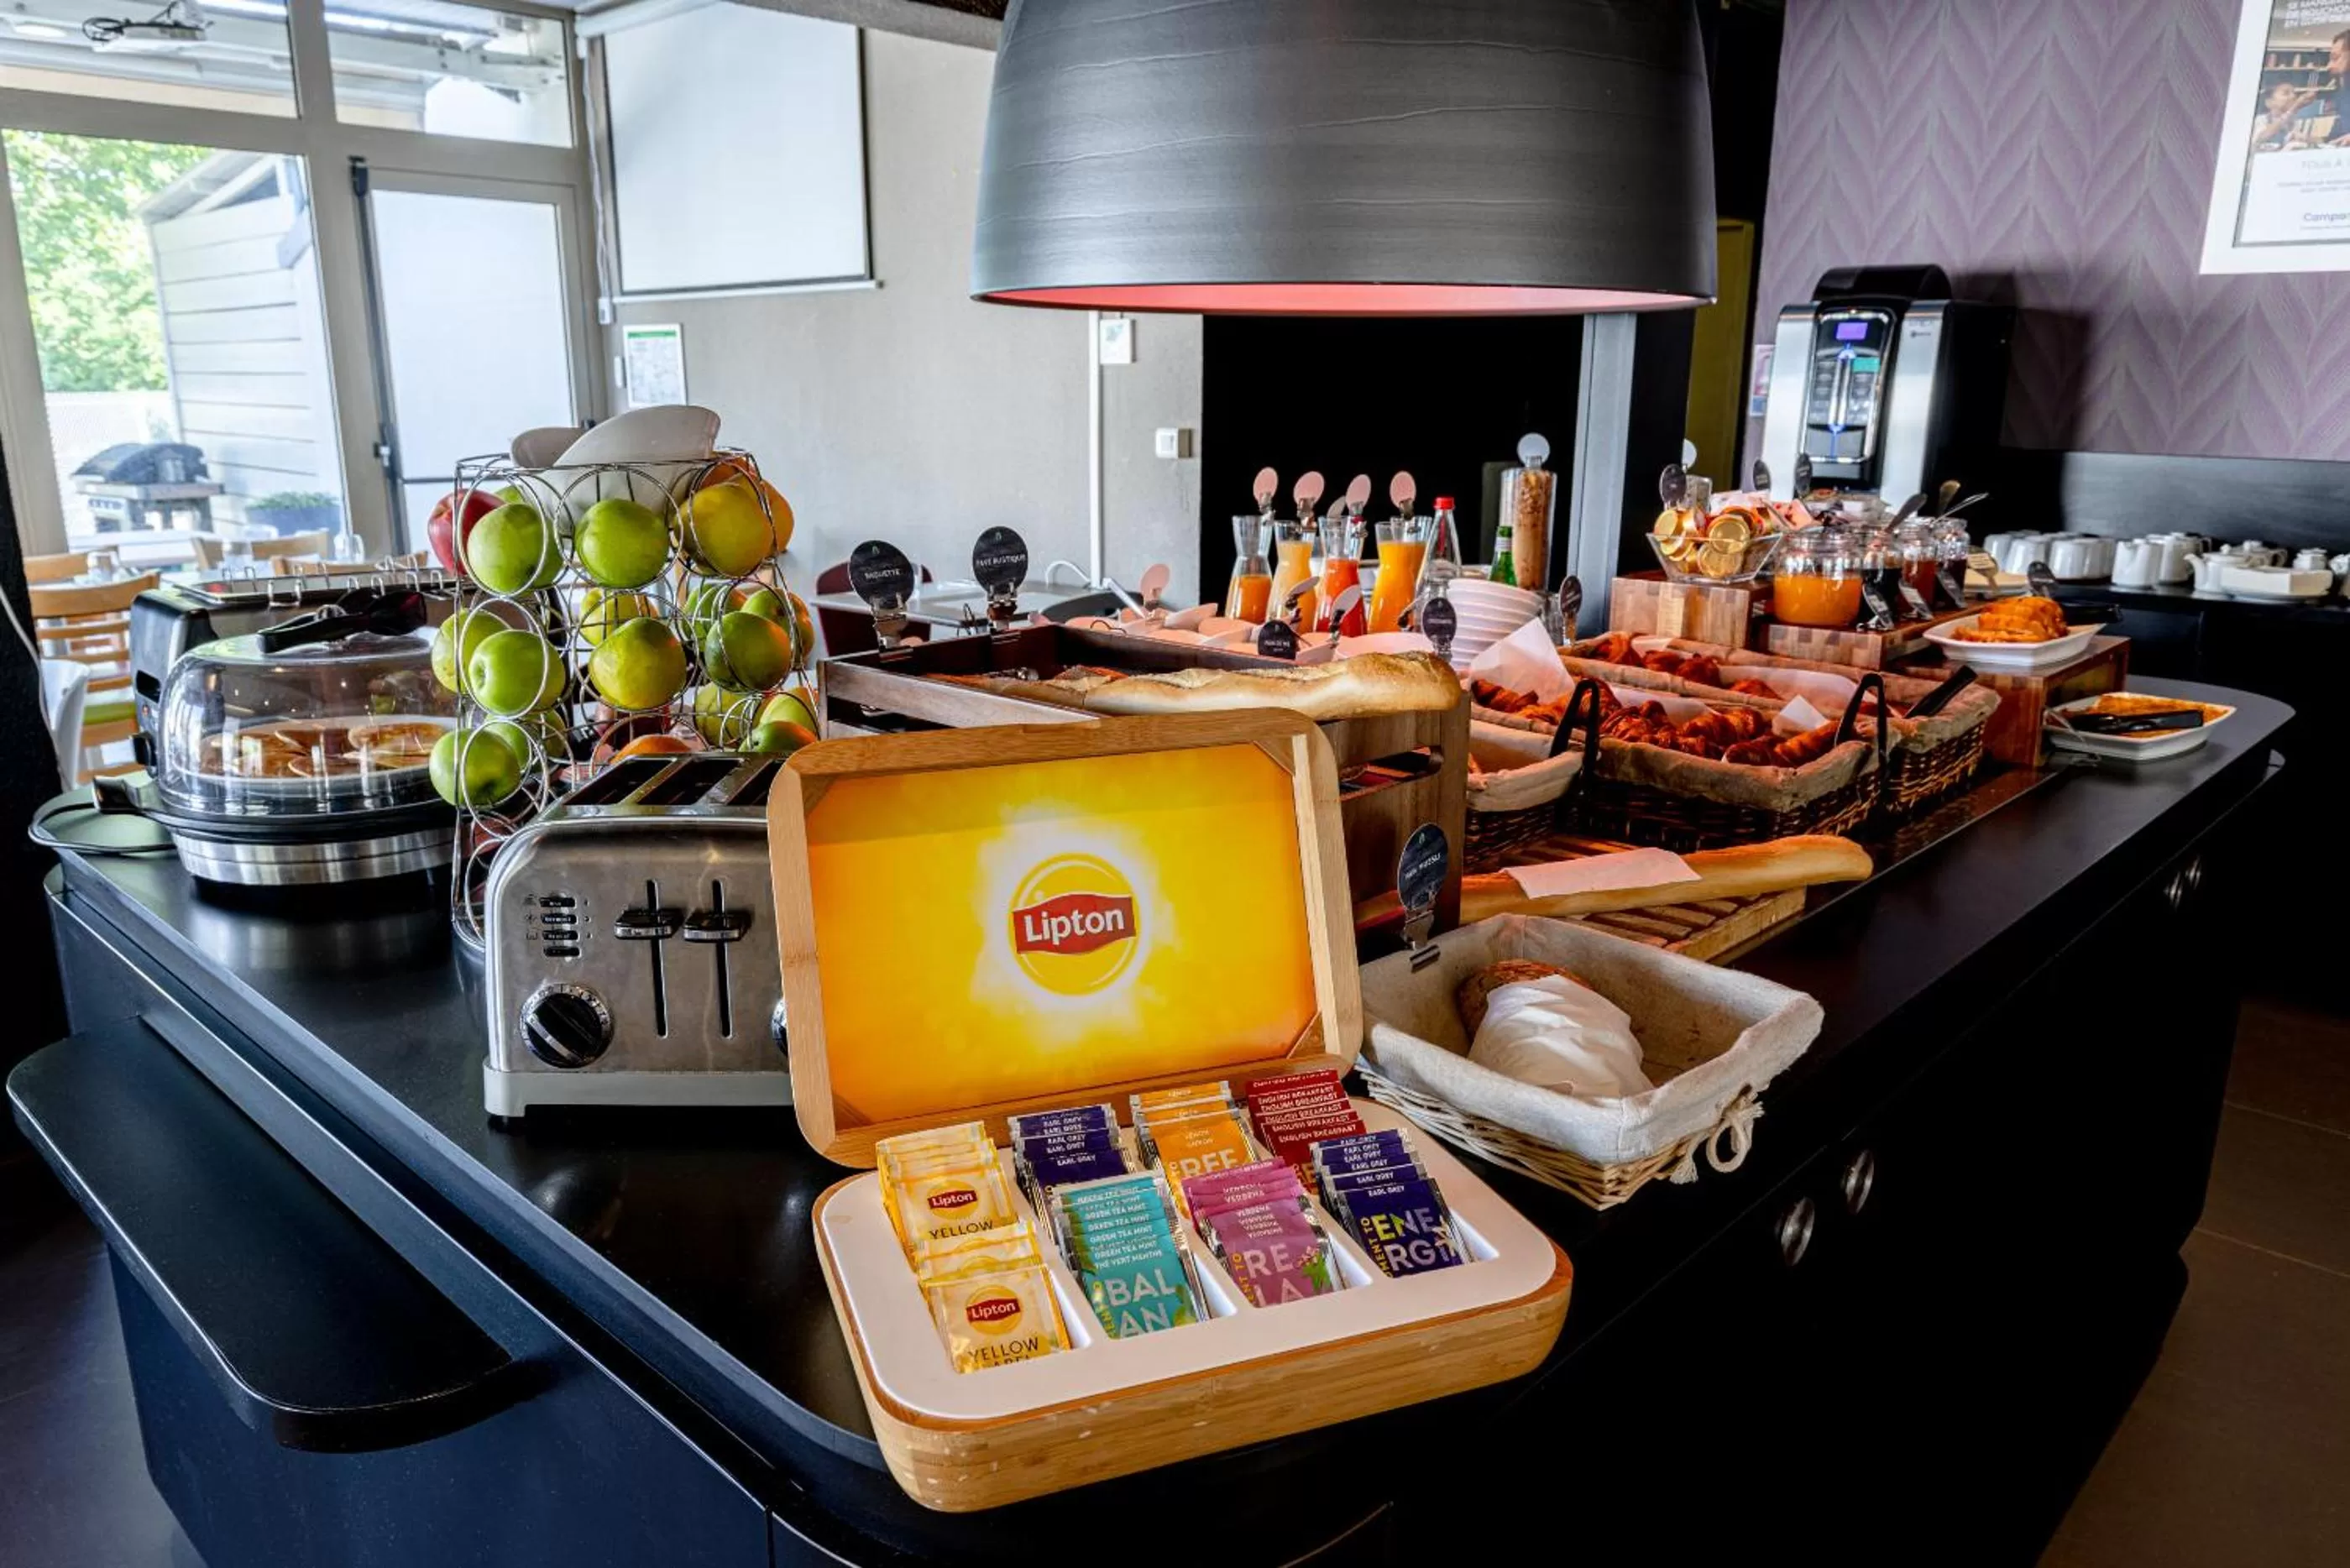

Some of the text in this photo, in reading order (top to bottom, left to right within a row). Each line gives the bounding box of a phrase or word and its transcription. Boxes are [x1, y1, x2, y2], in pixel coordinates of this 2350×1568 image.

[1023, 908, 1125, 946] Lipton
[932, 1190, 974, 1208] Lipton
[929, 1220, 993, 1240] YELLOW
[1243, 1242, 1294, 1278] RE
[1104, 1267, 1176, 1308] BAL
[971, 1301, 1017, 1319] Lipton
[1119, 1303, 1172, 1339] AN
[968, 1335, 1039, 1363] YELLOW
